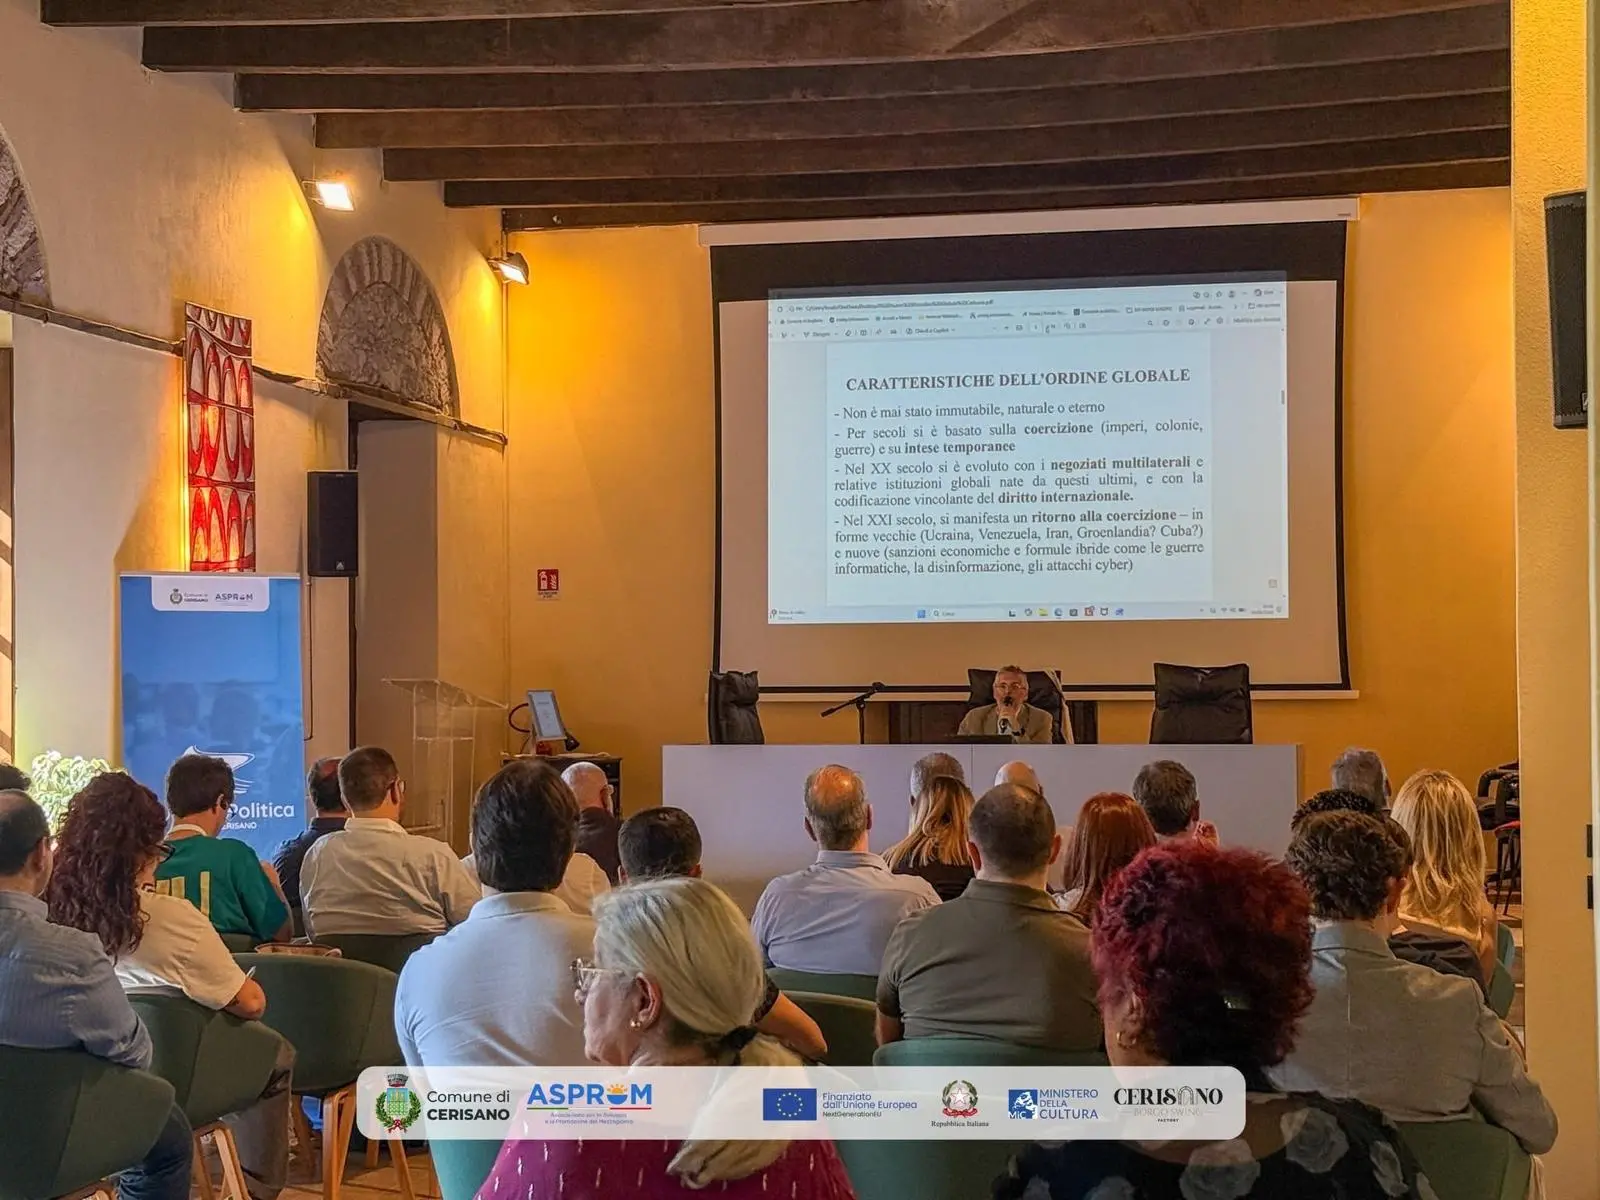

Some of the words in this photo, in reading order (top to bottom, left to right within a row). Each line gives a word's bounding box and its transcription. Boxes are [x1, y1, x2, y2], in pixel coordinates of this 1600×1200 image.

[846, 373, 995, 391] CARATTERISTICHE
[1111, 368, 1190, 383] GLOBALE
[842, 406, 867, 419] Non
[870, 406, 877, 418] è
[880, 405, 901, 418] mai
[904, 406, 932, 417] stato
[935, 402, 1004, 417] immutabile,
[1007, 401, 1054, 414] naturale
[1057, 404, 1065, 413] o
[1068, 402, 1105, 413] eterno
[847, 427, 866, 438] Per
[872, 425, 905, 438] secoli
[913, 425, 923, 437] si
[930, 425, 937, 437] è
[944, 424, 982, 436] basato
[989, 423, 1016, 435] sulla
[1024, 421, 1093, 434] coercizione
[1100, 420, 1147, 436] (imperi,
[1155, 419, 1203, 433] colonie,
[834, 442, 875, 458] guerre)
[878, 445, 886, 454] e
[888, 445, 901, 454] su
[904, 441, 939, 454] intese
[942, 441, 1016, 456] temporanee
[844, 462, 864, 475] Nel
[870, 462, 891, 474] XX
[896, 460, 933, 474] secolo
[936, 460, 948, 473] si
[953, 460, 960, 472] è
[965, 459, 1009, 472] evoluto
[1014, 462, 1035, 471] con
[1041, 458, 1045, 470] i
[1050, 457, 1106, 473] negoziati
[1112, 455, 1190, 468] multilaterali
[1196, 458, 1203, 467] e
[834, 478, 877, 491] relative
[885, 476, 942, 490] istituzioni
[950, 475, 990, 491] globali
[999, 477, 1024, 488] nate
[1032, 474, 1046, 486] da
[1054, 473, 1089, 489] questi
[1098, 472, 1137, 487] ultimi,
[1146, 475, 1153, 484] e
[1161, 475, 1183, 484] con
[1192, 471, 1203, 483] la
[834, 493, 911, 507] codificazione
[914, 492, 973, 505] vincolante
[976, 492, 994, 504] del
[997, 491, 1037, 503] diritto
[1040, 489, 1134, 502] internazionale.
[843, 514, 863, 526] Nel
[866, 513, 892, 526] XXI
[896, 512, 936, 527] secolo,
[939, 512, 949, 525] si
[953, 511, 1010, 524] manifesta
[1013, 514, 1028, 523] un
[1031, 510, 1076, 523] ritorno
[1079, 510, 1102, 521] alla
[1106, 508, 1177, 521] coercizione
[1192, 507, 1203, 519] in
[835, 530, 869, 542] forme
[872, 529, 916, 542] vecchie
[920, 528, 974, 545] (Ucraina,
[978, 527, 1041, 542] Venezuela,
[1046, 526, 1073, 540] Iran,
[1076, 525, 1156, 538] Groenlandia?
[1160, 524, 1203, 538] Cuba?)
[834, 550, 841, 558] e
[844, 549, 880, 558] nuove
[883, 545, 936, 562] (sanzioni
[940, 544, 1010, 557] economiche
[1013, 547, 1020, 555] e
[1025, 543, 1071, 555] formule
[1075, 542, 1110, 554] ibride
[1113, 545, 1146, 553] come
[1150, 541, 1161, 553] le
[1165, 544, 1204, 556] guerre
[834, 561, 910, 576] informatiche,
[914, 561, 924, 573] la
[927, 559, 1024, 575] disinformazione,
[1027, 559, 1043, 574] gli
[1046, 558, 1092, 571] attacchi
[1094, 558, 1133, 574] cyber)
[228, 802, 295, 818] Politica
